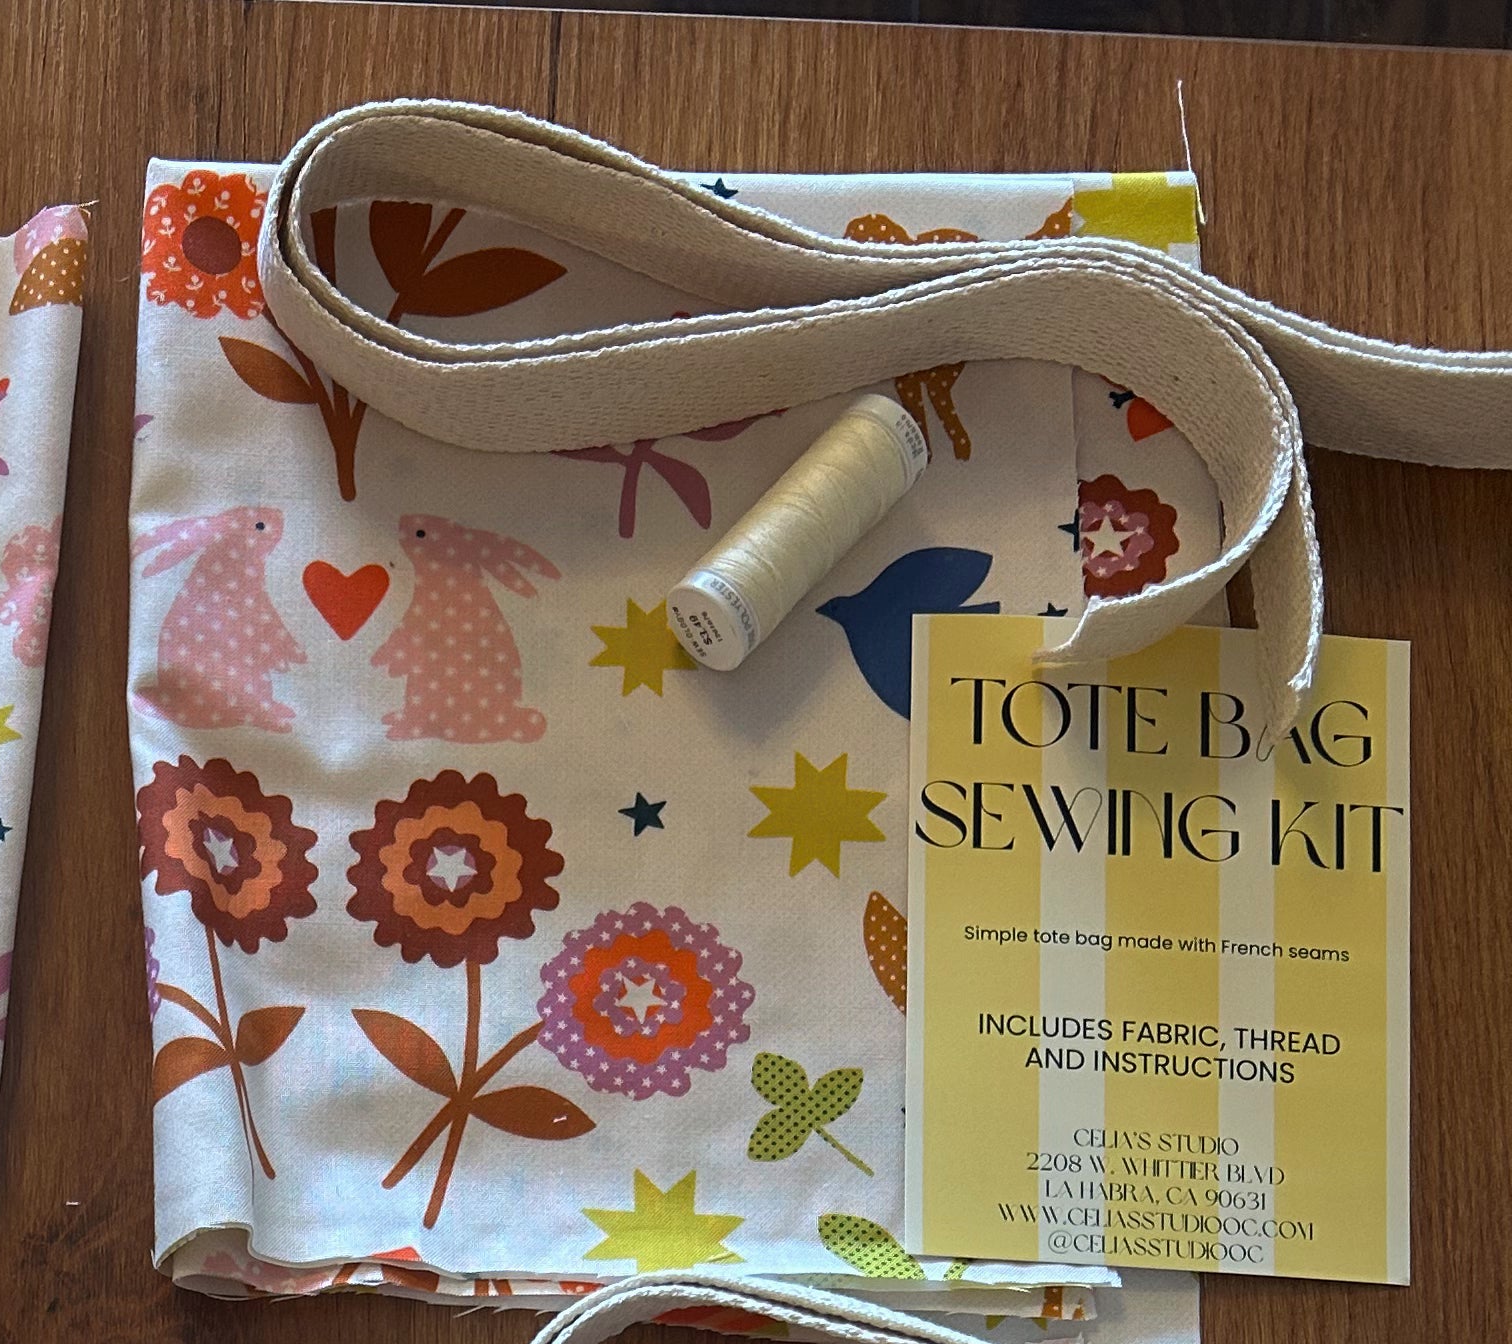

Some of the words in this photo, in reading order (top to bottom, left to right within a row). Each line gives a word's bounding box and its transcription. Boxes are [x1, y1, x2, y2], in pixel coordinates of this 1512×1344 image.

[950, 677, 1169, 755] TOTE
[1200, 687, 1373, 768] BAG
[915, 780, 1240, 863] SEWING
[1271, 798, 1405, 873] KIT
[964, 925, 1029, 946] Simple
[1033, 928, 1071, 945] tote
[1075, 929, 1113, 952] bag
[1117, 934, 1174, 951] made
[1177, 936, 1217, 953] with
[1221, 939, 1284, 958] French
[1287, 946, 1350, 963] seams
[979, 1013, 1113, 1042] INCLUDES
[1122, 1020, 1227, 1053] FABRIC,
[1233, 1027, 1341, 1056] THREAD
[1025, 1046, 1086, 1070] AND
[1093, 1050, 1295, 1084] INSTRUCTIONS
[1073, 1128, 1152, 1151] CELIA'S
[1157, 1133, 1240, 1157] STUDIO
[1026, 1152, 1083, 1174] 2208
[1089, 1154, 1115, 1176] W.
[1121, 1156, 1220, 1182] WHITTIER
[1227, 1163, 1285, 1185] BLVD
[1045, 1178, 1074, 1199] LA
[1080, 1180, 1160, 1206] HABRA,
[1165, 1186, 1198, 1207] CA
[1204, 1188, 1266, 1211] 90631
[998, 1201, 1314, 1242] WWW.CELIASSTUDIOOC.COM
[1047, 1229, 1269, 1264] @CELIASSTUDIOOC
